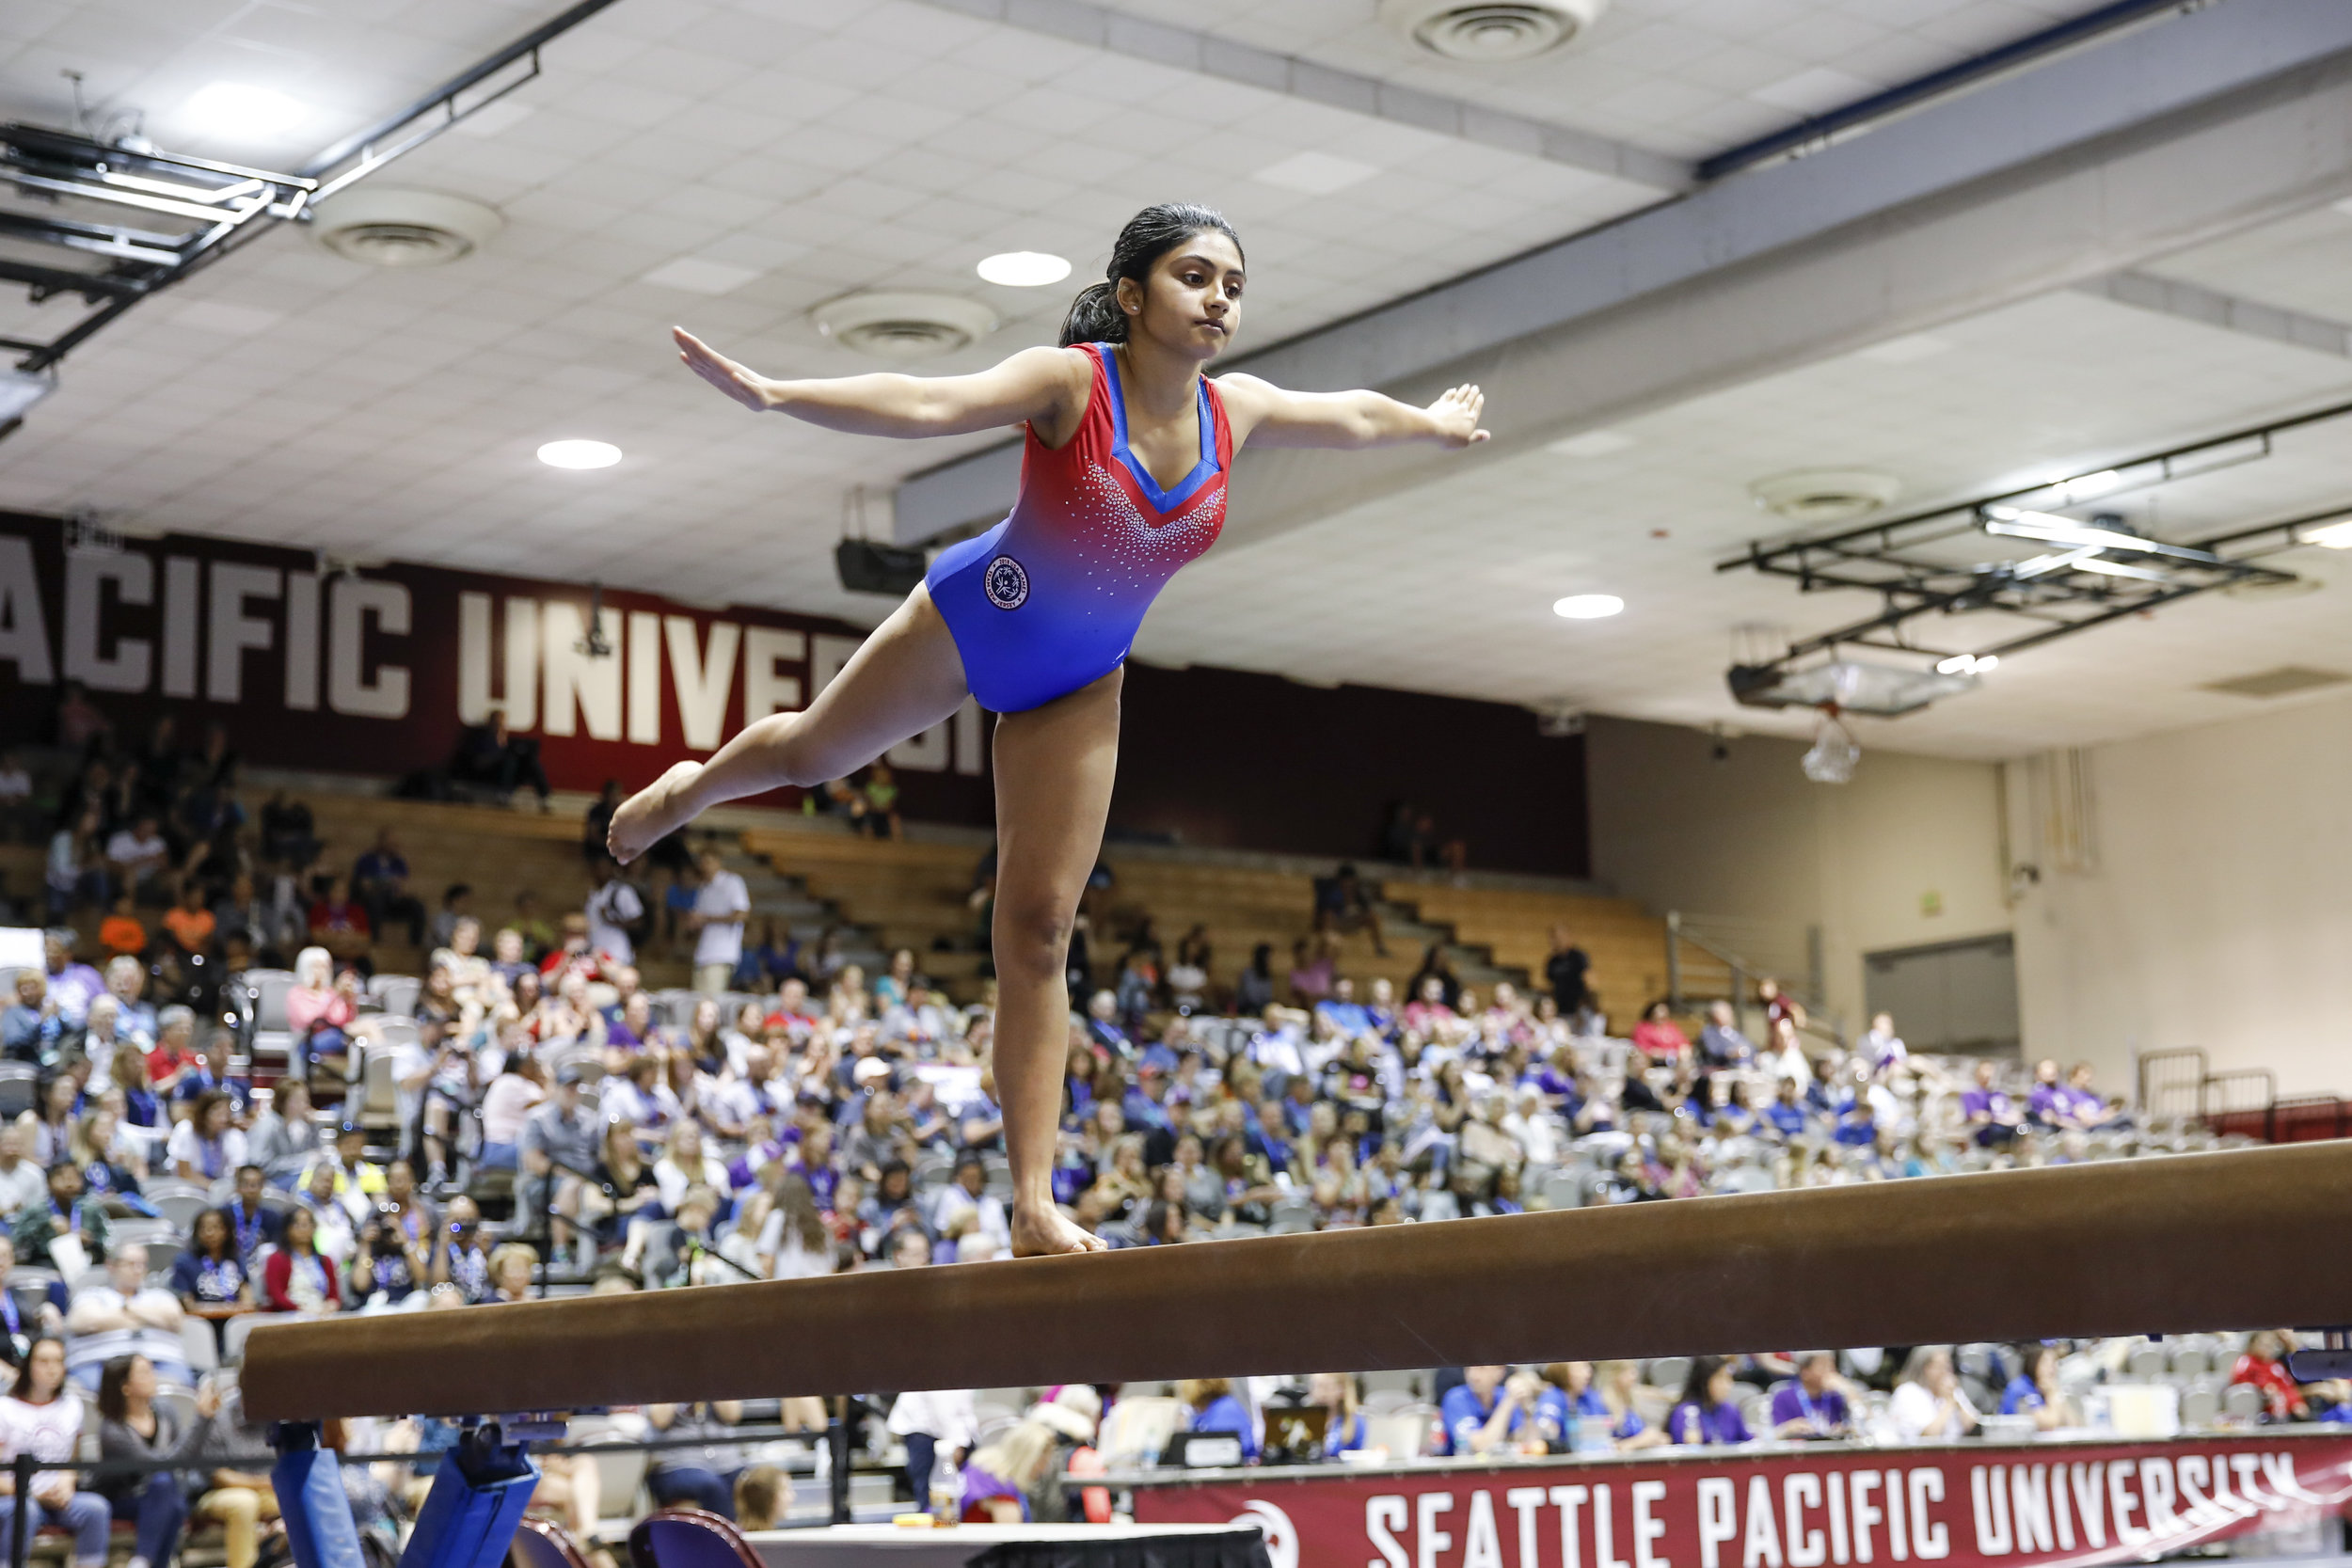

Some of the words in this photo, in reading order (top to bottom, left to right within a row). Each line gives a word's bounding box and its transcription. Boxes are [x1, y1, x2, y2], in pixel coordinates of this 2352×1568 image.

[1010, 562, 1019, 572] USA
[988, 588, 997, 601] NEW
[1365, 1481, 1672, 1568] SEATTLE
[1696, 1467, 1949, 1568] PACIFIC
[1971, 1451, 2314, 1557] UNIVERSITY
